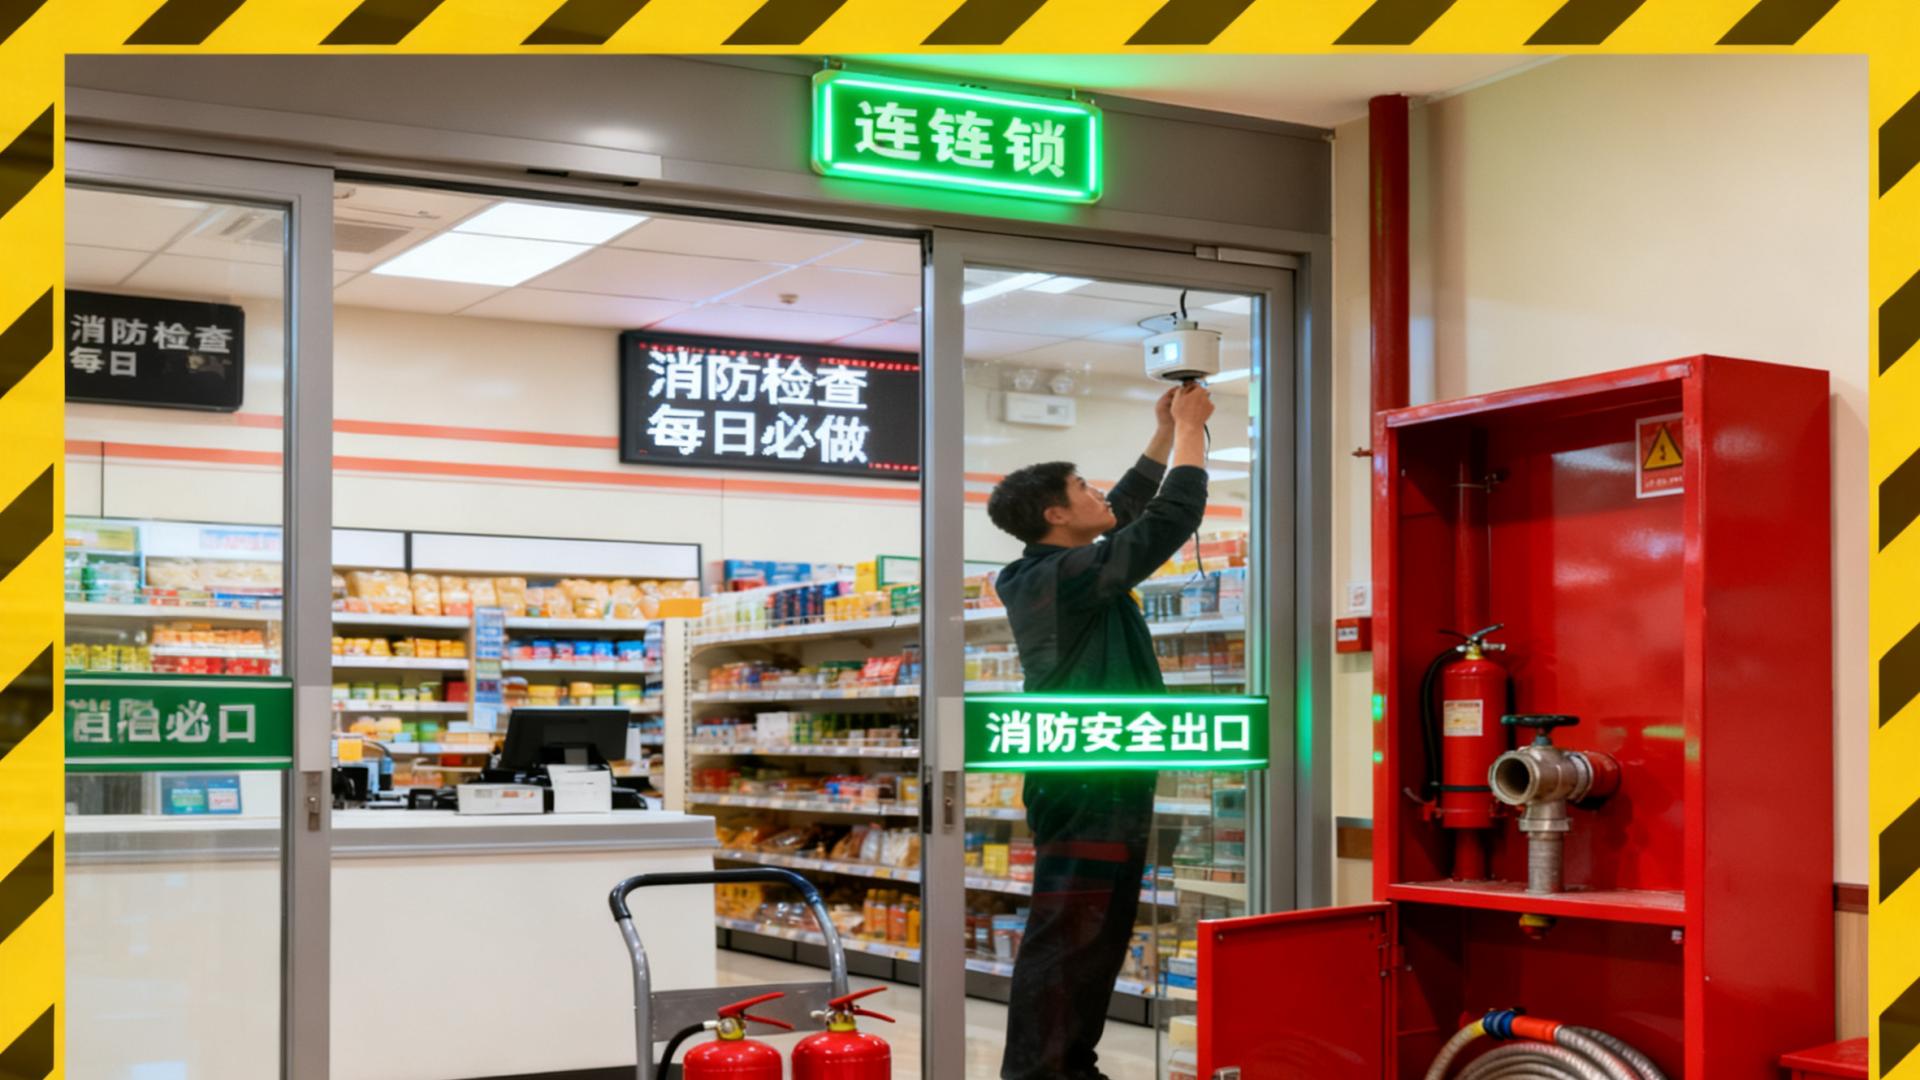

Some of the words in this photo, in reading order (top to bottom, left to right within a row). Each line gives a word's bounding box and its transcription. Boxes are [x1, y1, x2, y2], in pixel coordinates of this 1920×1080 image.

[70, 313, 234, 354] 消防检查
[69, 346, 137, 378] 每日
[647, 347, 868, 410] 消防检查
[647, 403, 869, 463] 每日必做
[986, 709, 1251, 754] 消防安全出口
